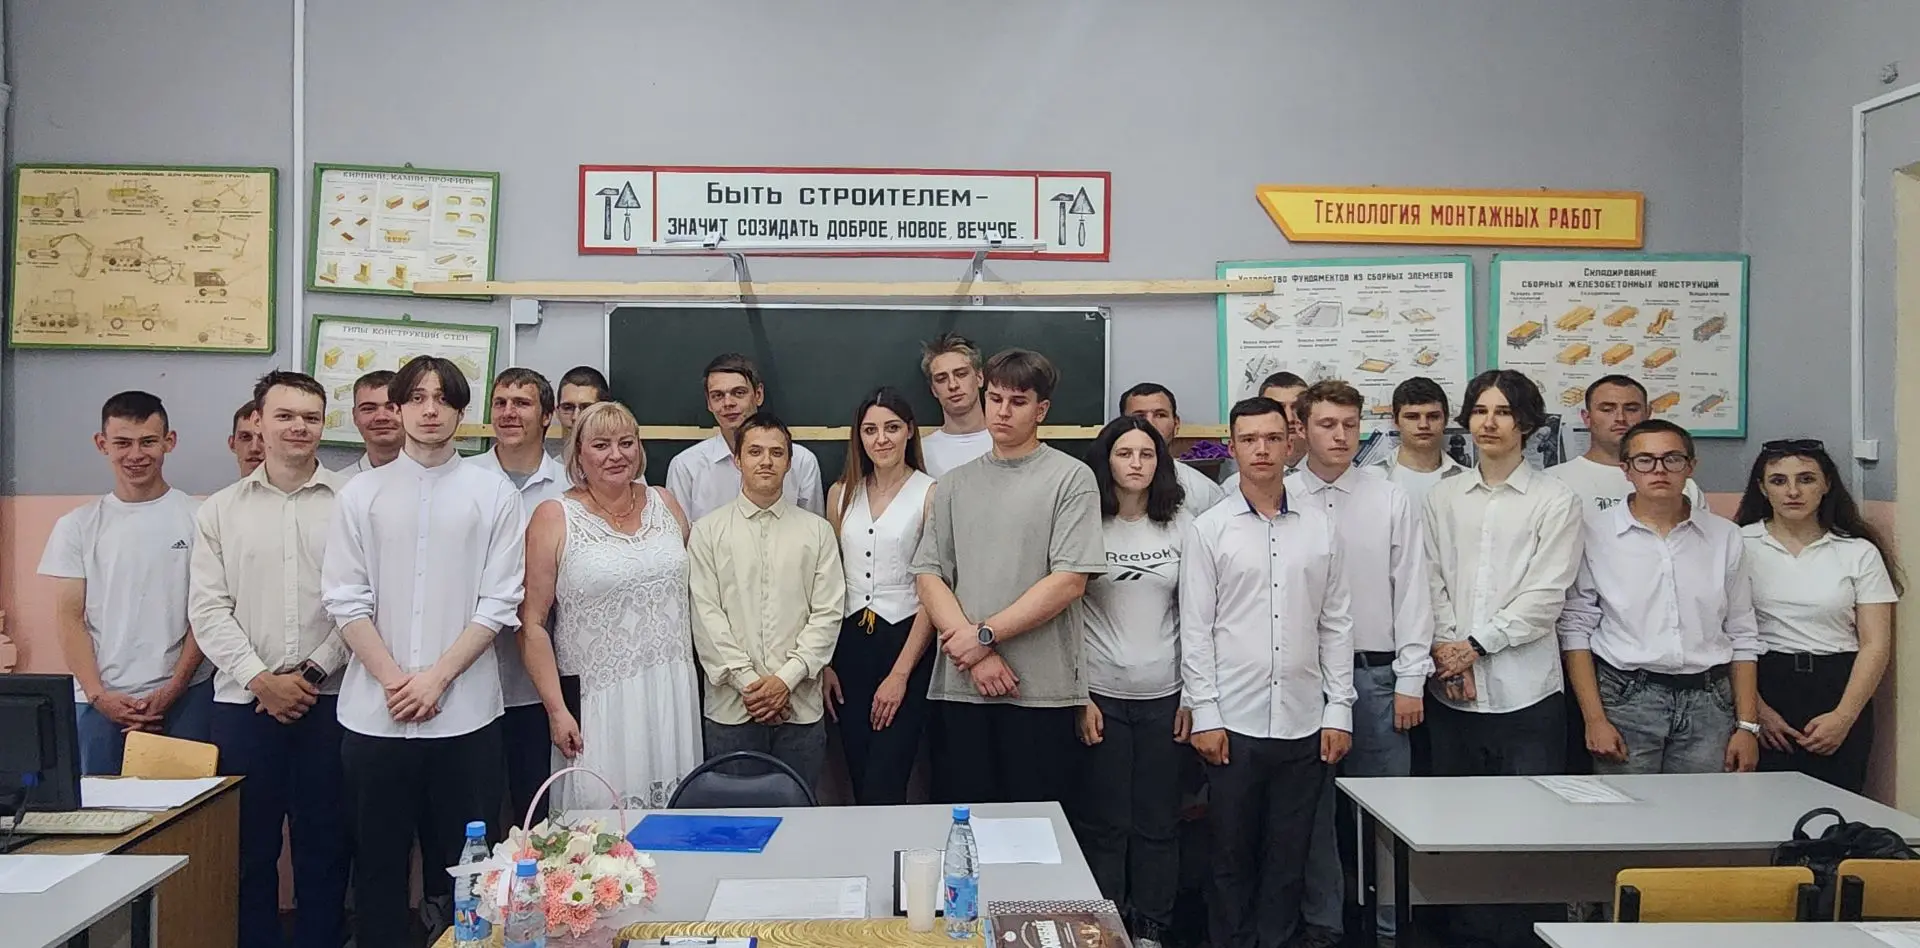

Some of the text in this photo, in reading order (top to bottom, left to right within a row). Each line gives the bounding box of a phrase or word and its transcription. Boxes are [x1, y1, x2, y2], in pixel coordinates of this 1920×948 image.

[1314, 199, 1603, 230] ТЕХНОЛОГИЯ МОНТАЖНЫХ РАБОТ
[667, 217, 729, 237] ЗНАЧИТ
[737, 218, 819, 241] СОЗИДАТЬ
[827, 219, 894, 241] ДОБРОЕ,
[897, 220, 953, 241] НОВОЕ,
[1291, 273, 1350, 283] ФУНДАМЕНТОВ
[1353, 273, 1363, 281] ИЗ
[1367, 272, 1404, 281] СБОРНЫХ
[1407, 271, 1454, 280] ЭЛЕМЕНТОВ
[1583, 267, 1657, 277] СКЛАДИРОВАНИЕ
[1521, 279, 1719, 289] СБОРНЫХ ЖЕЛЕЗОБЕТОННЫХ КОНСТРУКЦИЙ
[444, 332, 469, 341] СТЕН
[1105, 548, 1172, 563] Reebok
